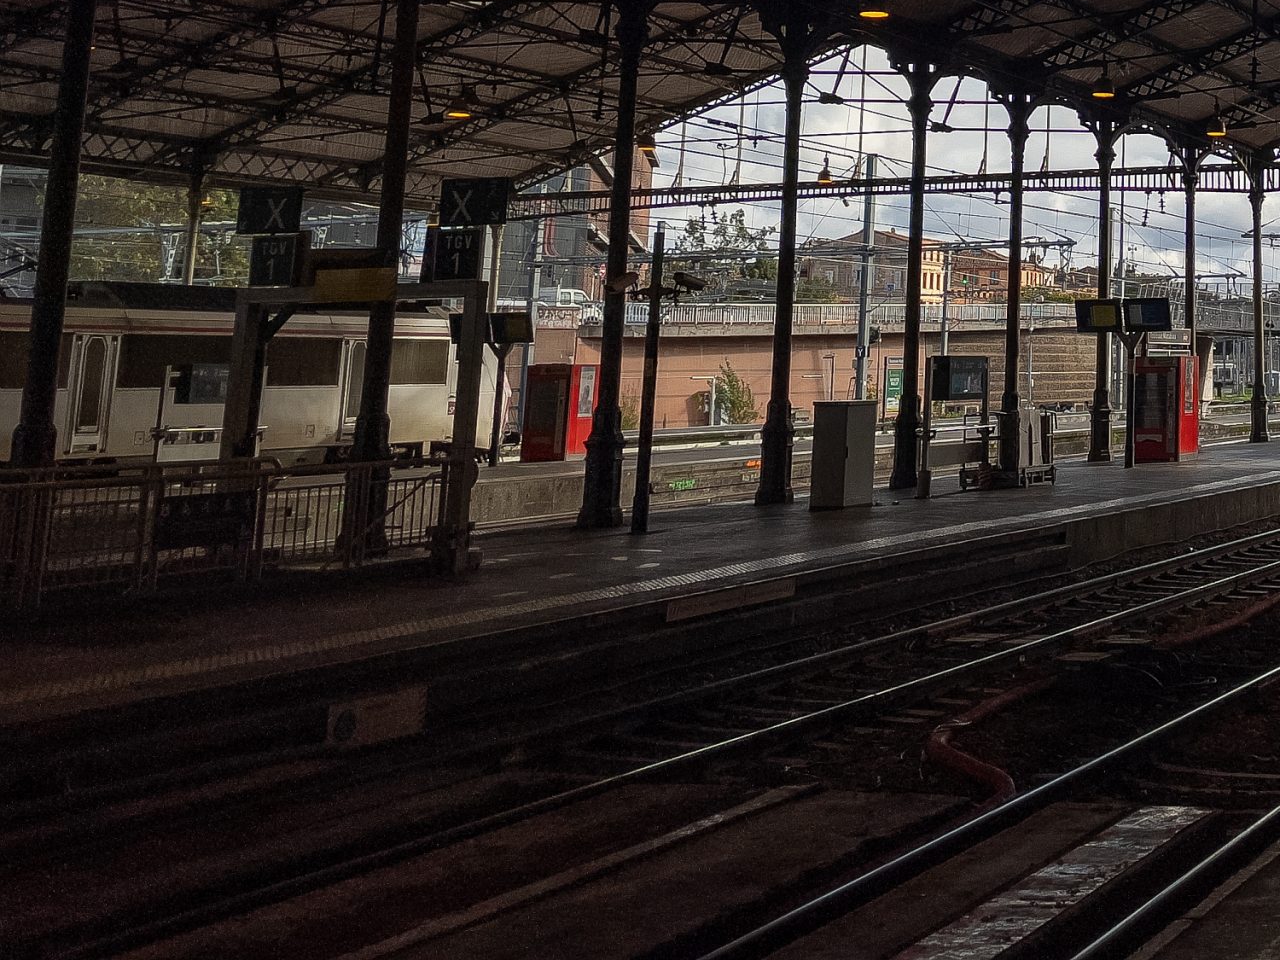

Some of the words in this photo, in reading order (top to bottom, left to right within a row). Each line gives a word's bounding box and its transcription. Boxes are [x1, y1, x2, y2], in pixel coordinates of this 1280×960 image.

[264, 197, 287, 230] X
[450, 189, 474, 223] X
[261, 240, 288, 256] TGV
[446, 234, 473, 250] TGV
[266, 257, 275, 281] 1
[450, 251, 461, 276] 1
[857, 347, 864, 358] Y
